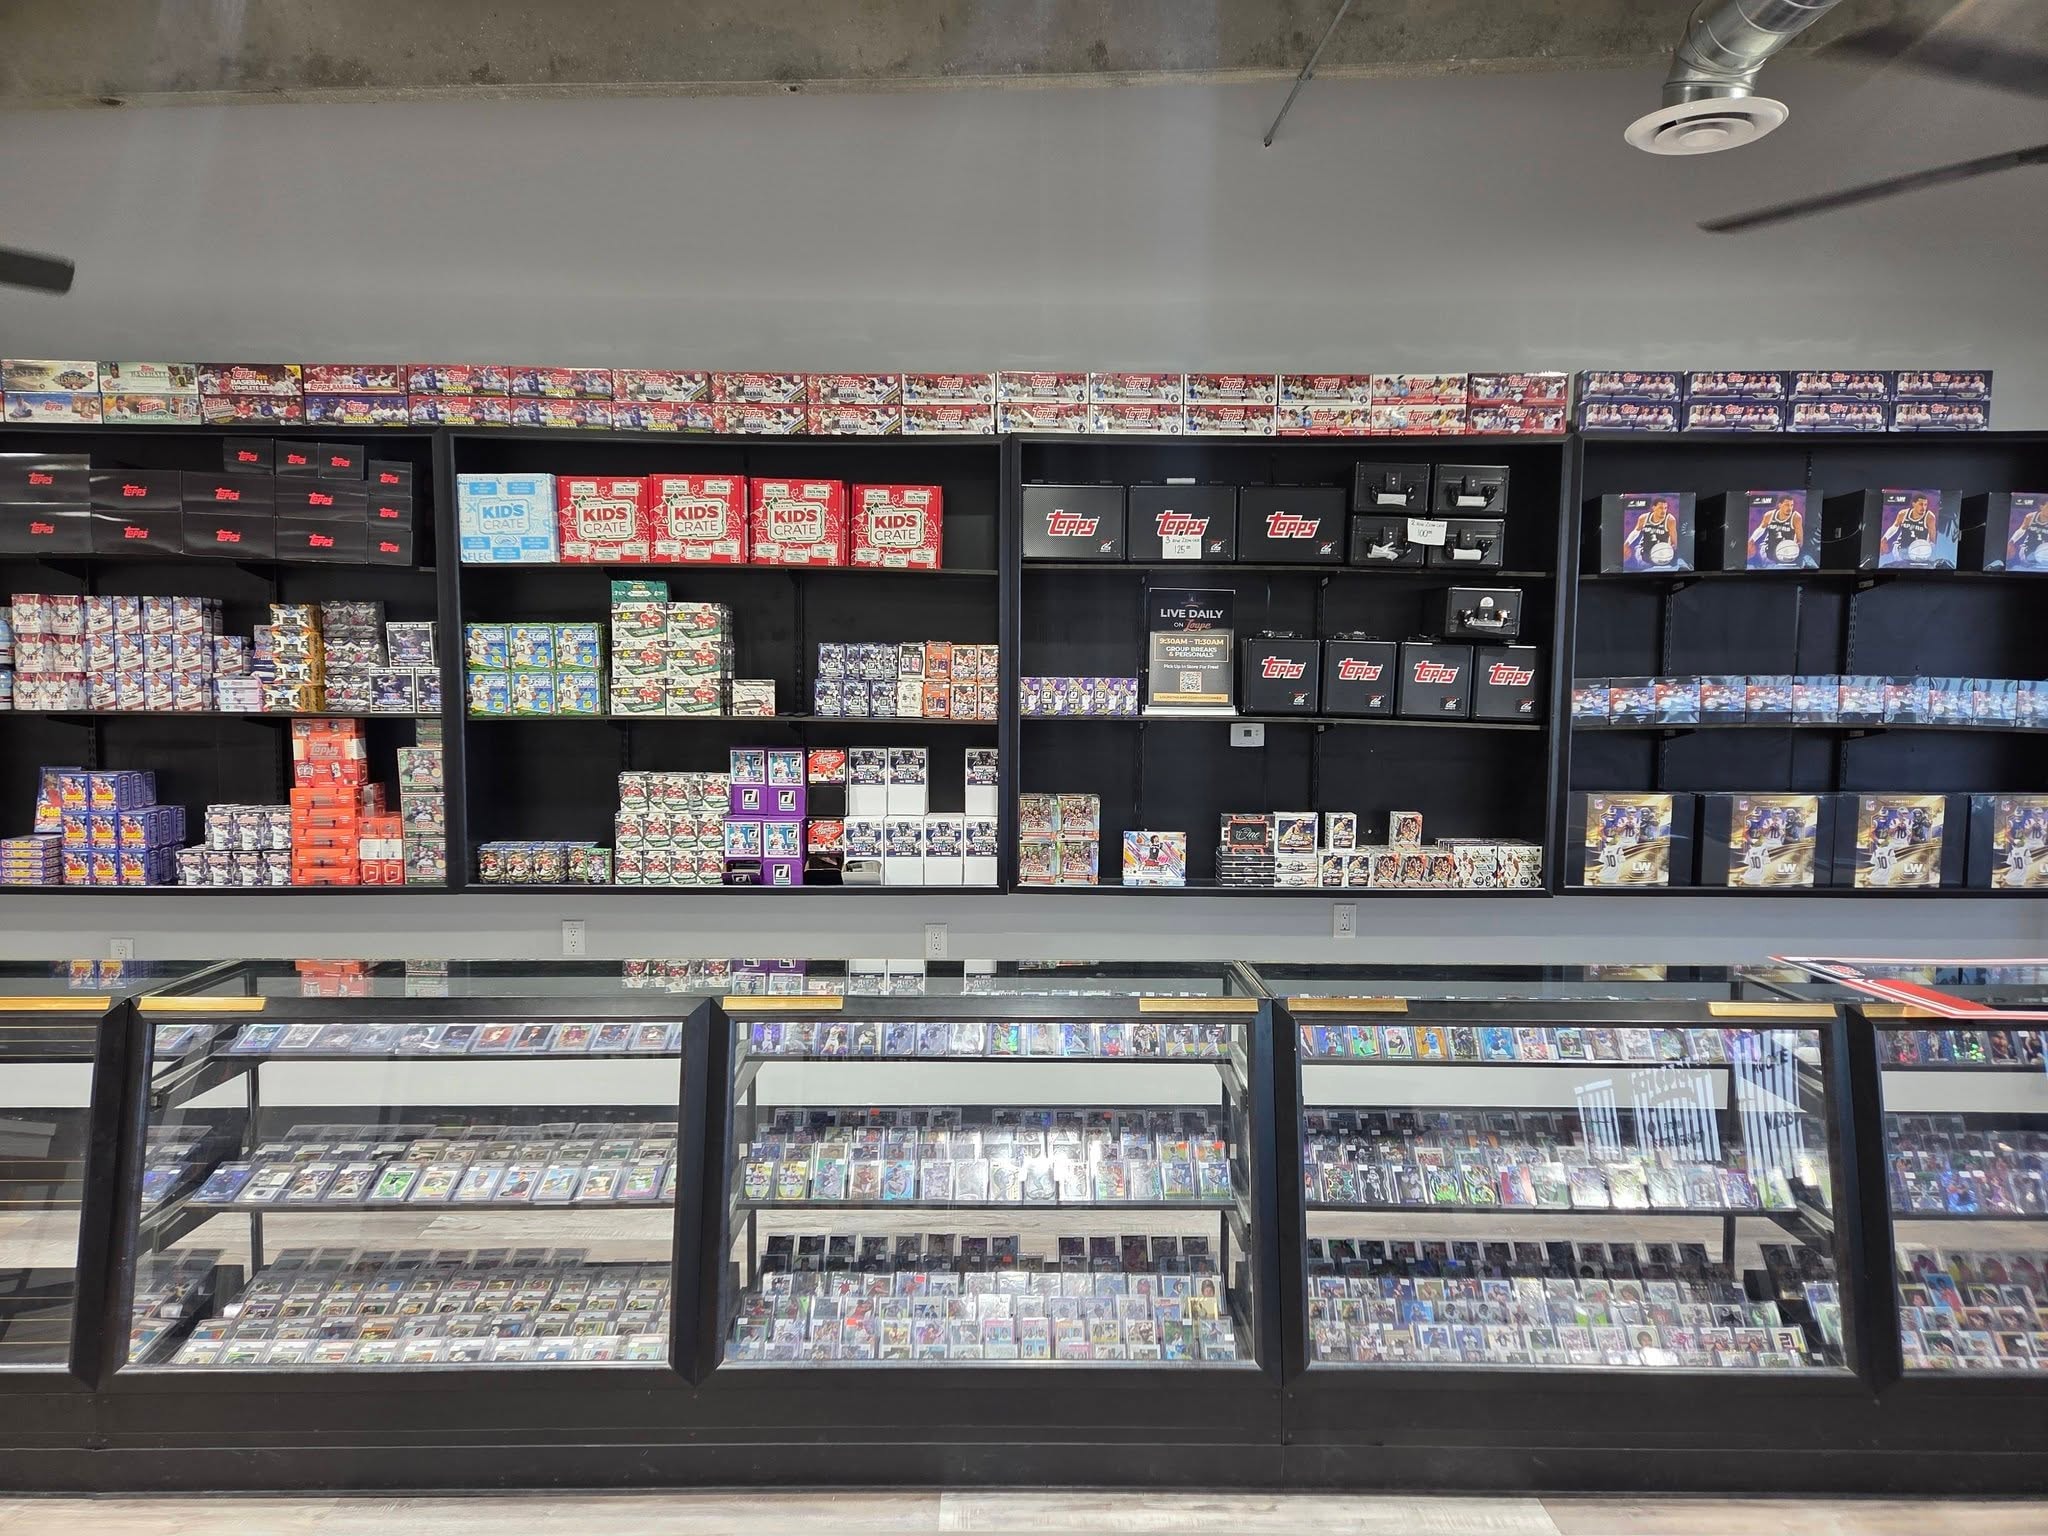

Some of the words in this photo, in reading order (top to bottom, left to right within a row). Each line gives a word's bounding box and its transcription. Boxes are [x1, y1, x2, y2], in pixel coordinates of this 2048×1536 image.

[937, 376, 963, 389] Topps
[1031, 375, 1056, 388] Topps
[1126, 376, 1151, 389] Topps
[1219, 377, 1245, 389] Topps
[1314, 377, 1340, 389] Topps
[1408, 378, 1432, 389] Topps
[137, 400, 161, 413] Topps
[1032, 406, 1058, 419] Topps
[936, 407, 962, 420] Topps
[1125, 407, 1151, 420] Topps
[1218, 407, 1244, 420] Topps
[28, 472, 53, 485] Topps
[379, 473, 399, 484] Topps
[123, 484, 147, 497] Topps
[214, 488, 240, 501] Topps
[308, 492, 334, 506] Topps
[379, 507, 399, 518] Topps
[482, 503, 524, 519] KID'S
[583, 506, 627, 521] KID'S
[674, 504, 719, 520] KID'S
[774, 507, 818, 523] KID'S
[484, 519, 524, 530] CRATE
[675, 520, 718, 532] CRATE
[874, 513, 918, 528] KID'S
[1046, 509, 1100, 537] Topps
[1156, 510, 1210, 537] Topps
[1266, 511, 1320, 538] Topps
[30, 522, 55, 534] Topps
[124, 526, 149, 539] Topps
[584, 522, 627, 534] CRATE
[774, 523, 817, 536] CRATE
[875, 528, 916, 541] CRATE
[216, 529, 241, 542] Topps
[309, 534, 334, 547] Topps
[379, 541, 400, 553] Topps
[1160, 608, 1186, 618] LIVE
[1189, 609, 1224, 619] DAILY
[1262, 656, 1306, 680] Topps
[1338, 657, 1383, 681] Topps
[1414, 660, 1459, 684] Topps
[1488, 663, 1535, 686] Topps
[1606, 855, 1617, 868] 10
[1631, 861, 1652, 872] LW
[1751, 856, 1761, 869] 10
[1777, 863, 1796, 873] LW
[1877, 856, 1888, 870] 10
[1903, 863, 1923, 873] LW
[2013, 856, 2024, 870] 10
